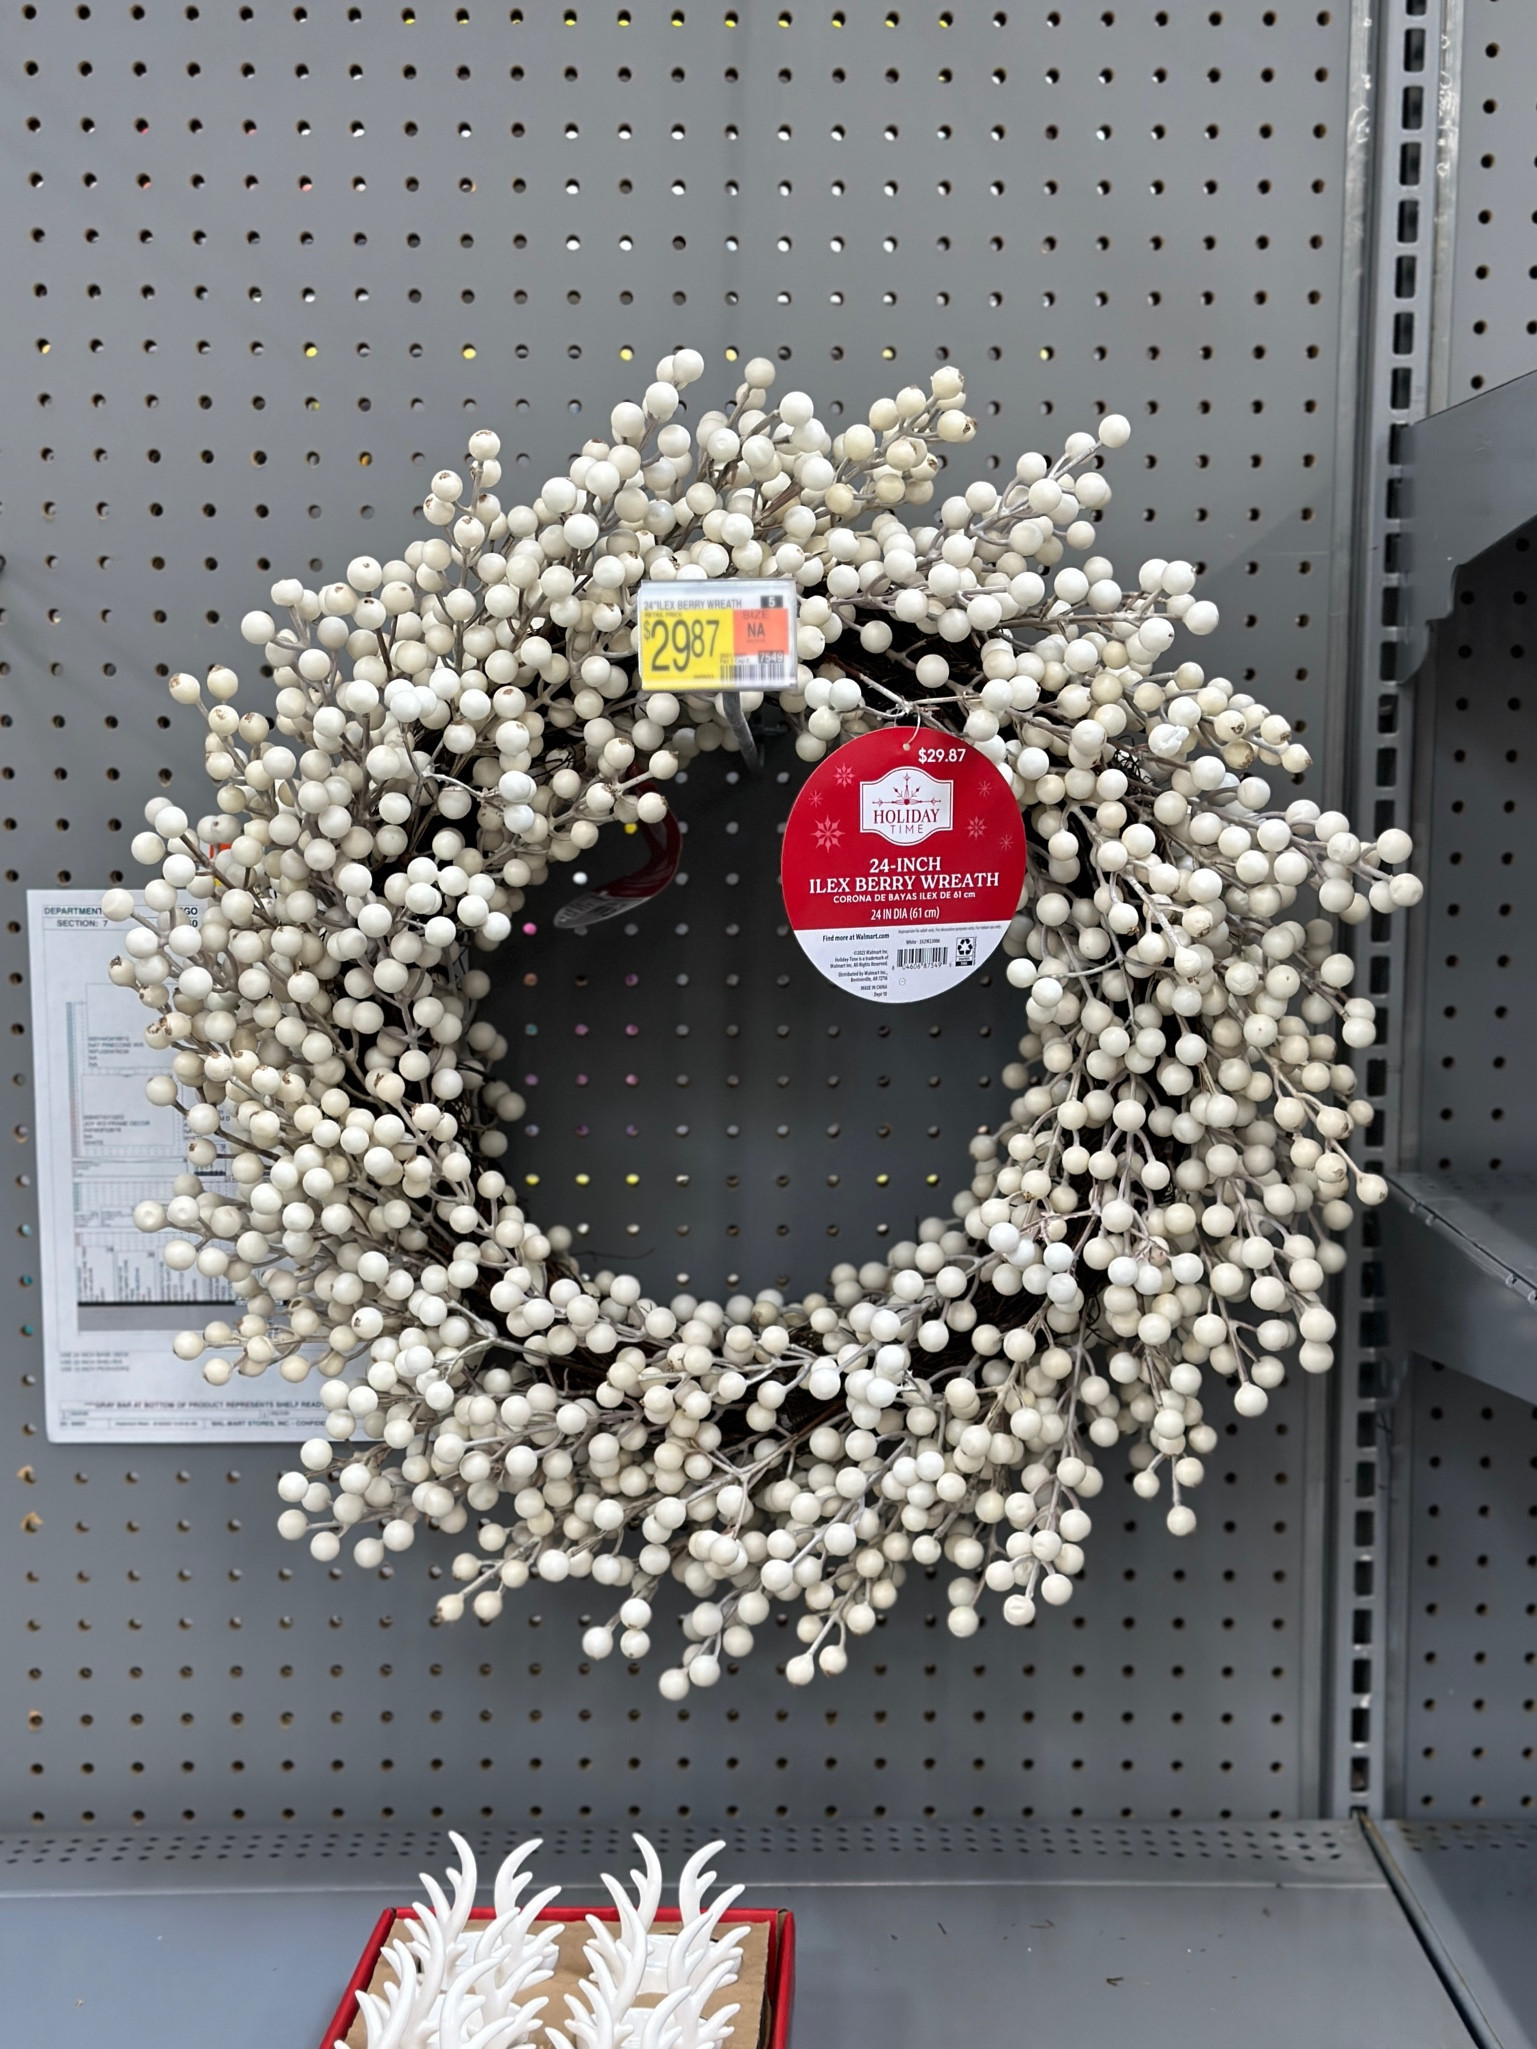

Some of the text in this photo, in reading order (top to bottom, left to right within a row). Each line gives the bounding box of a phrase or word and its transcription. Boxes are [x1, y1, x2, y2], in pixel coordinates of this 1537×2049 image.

[677, 599, 705, 610] BERRY
[707, 599, 742, 609] WREATH
[768, 597, 775, 607] 5
[742, 610, 769, 619] SIZE
[747, 623, 765, 638] NA
[759, 653, 783, 663] 7549
[918, 748, 966, 764] $29.87
[873, 808, 940, 825] HOLIDAY
[890, 824, 924, 835] TIME
[869, 857, 942, 873] 24-INCH
[809, 872, 1000, 894] ILEX BERRY WREATH
[833, 894, 872, 904] CORONA
[874, 893, 886, 902] DE
[888, 893, 918, 902] BAYAS
[919, 892, 938, 900] ILEX
[940, 891, 952, 899] DE
[953, 890, 962, 899] 61
[44, 907, 103, 915] DEPARTMENT
[871, 906, 941, 921] 24 IN DIA (61 cm)
[57, 919, 99, 928] SECTION:
[103, 919, 108, 927] 7
[823, 934, 834, 942] Find
[855, 933, 890, 941] Walmart.com
